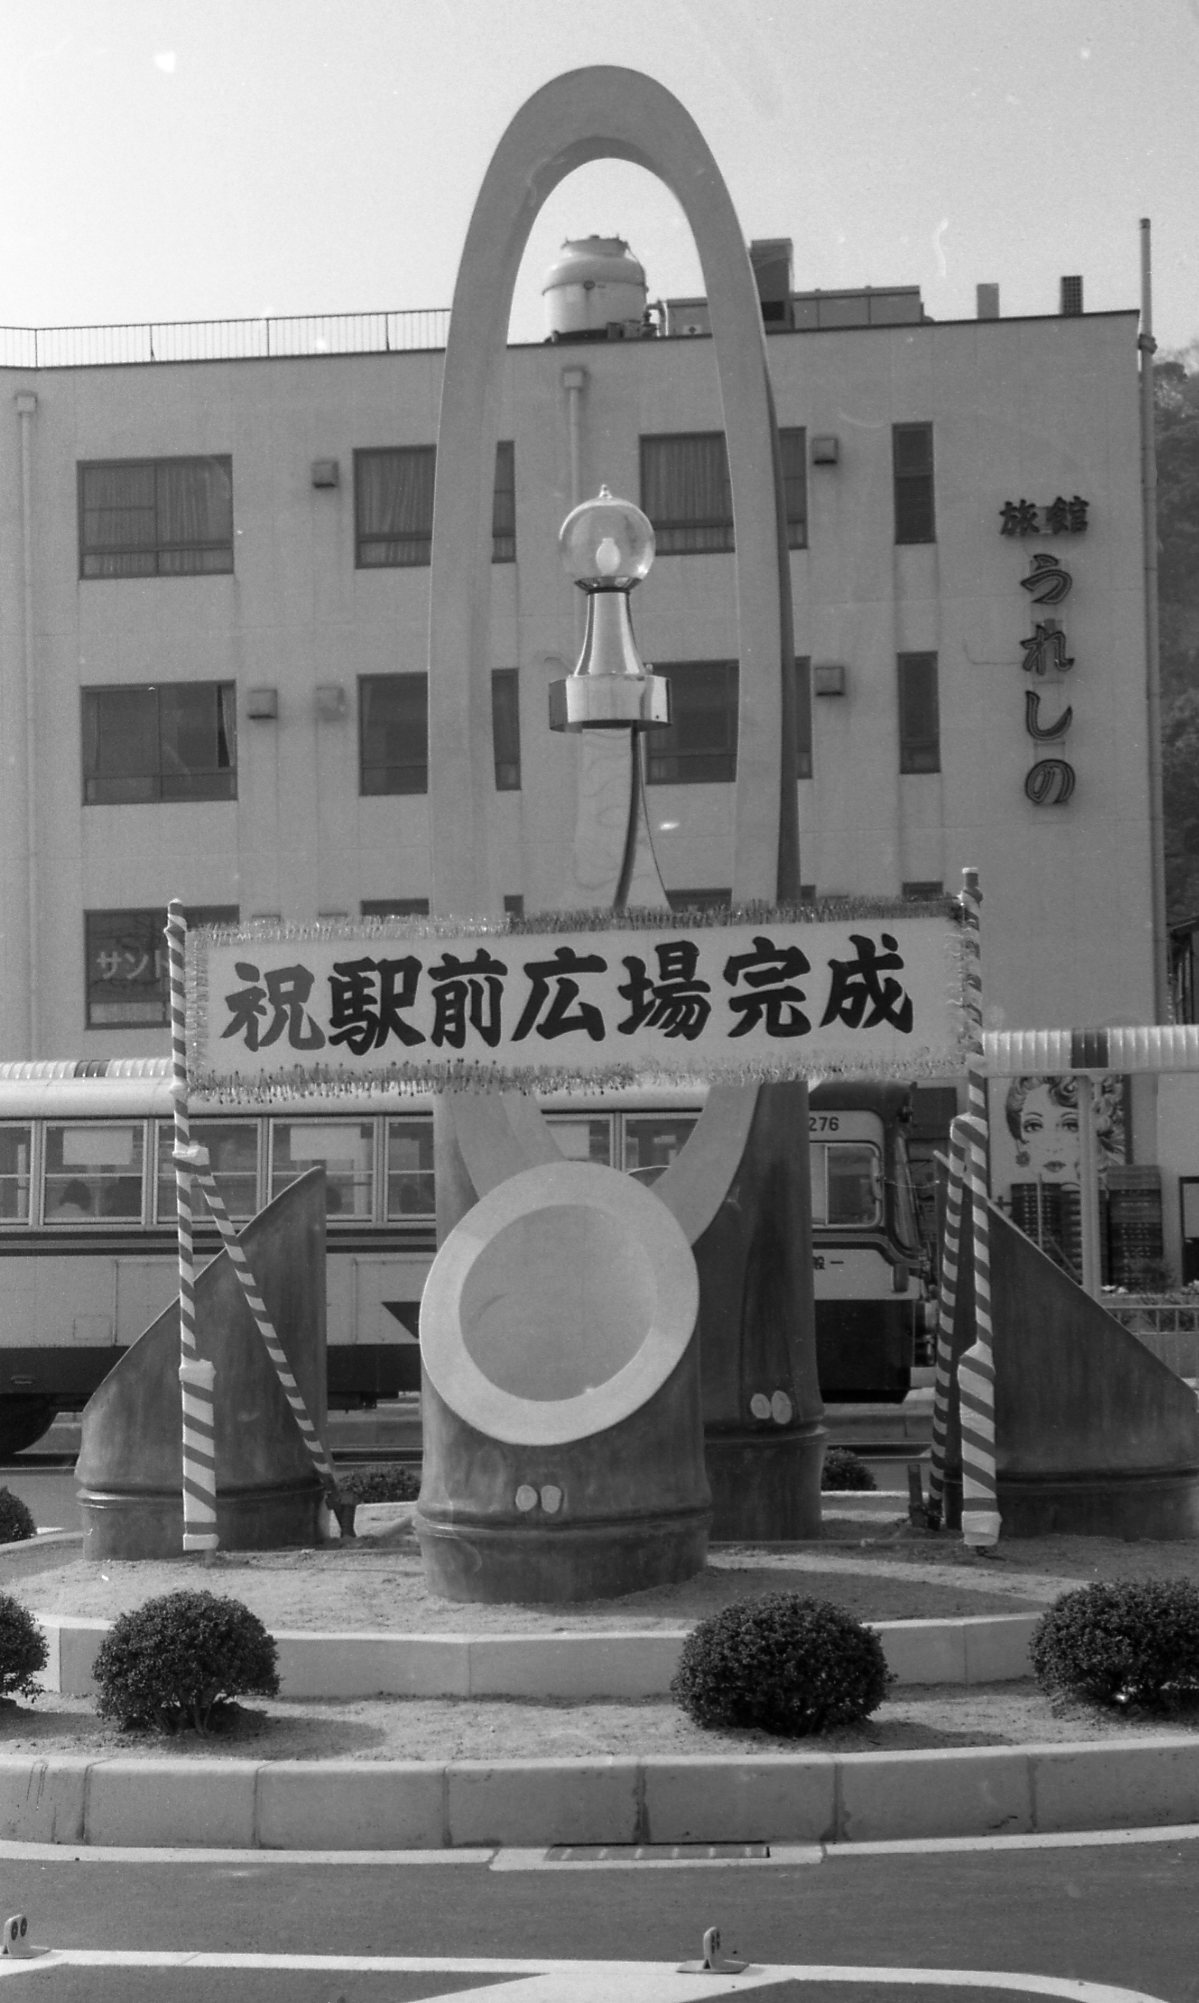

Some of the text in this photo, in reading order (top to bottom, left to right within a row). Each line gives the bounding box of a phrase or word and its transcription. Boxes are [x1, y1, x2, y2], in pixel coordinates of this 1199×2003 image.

[999, 496, 1089, 534] 旅館
[1019, 553, 1076, 804] うれしの
[219, 933, 913, 1055] 祝駅前広場完成
